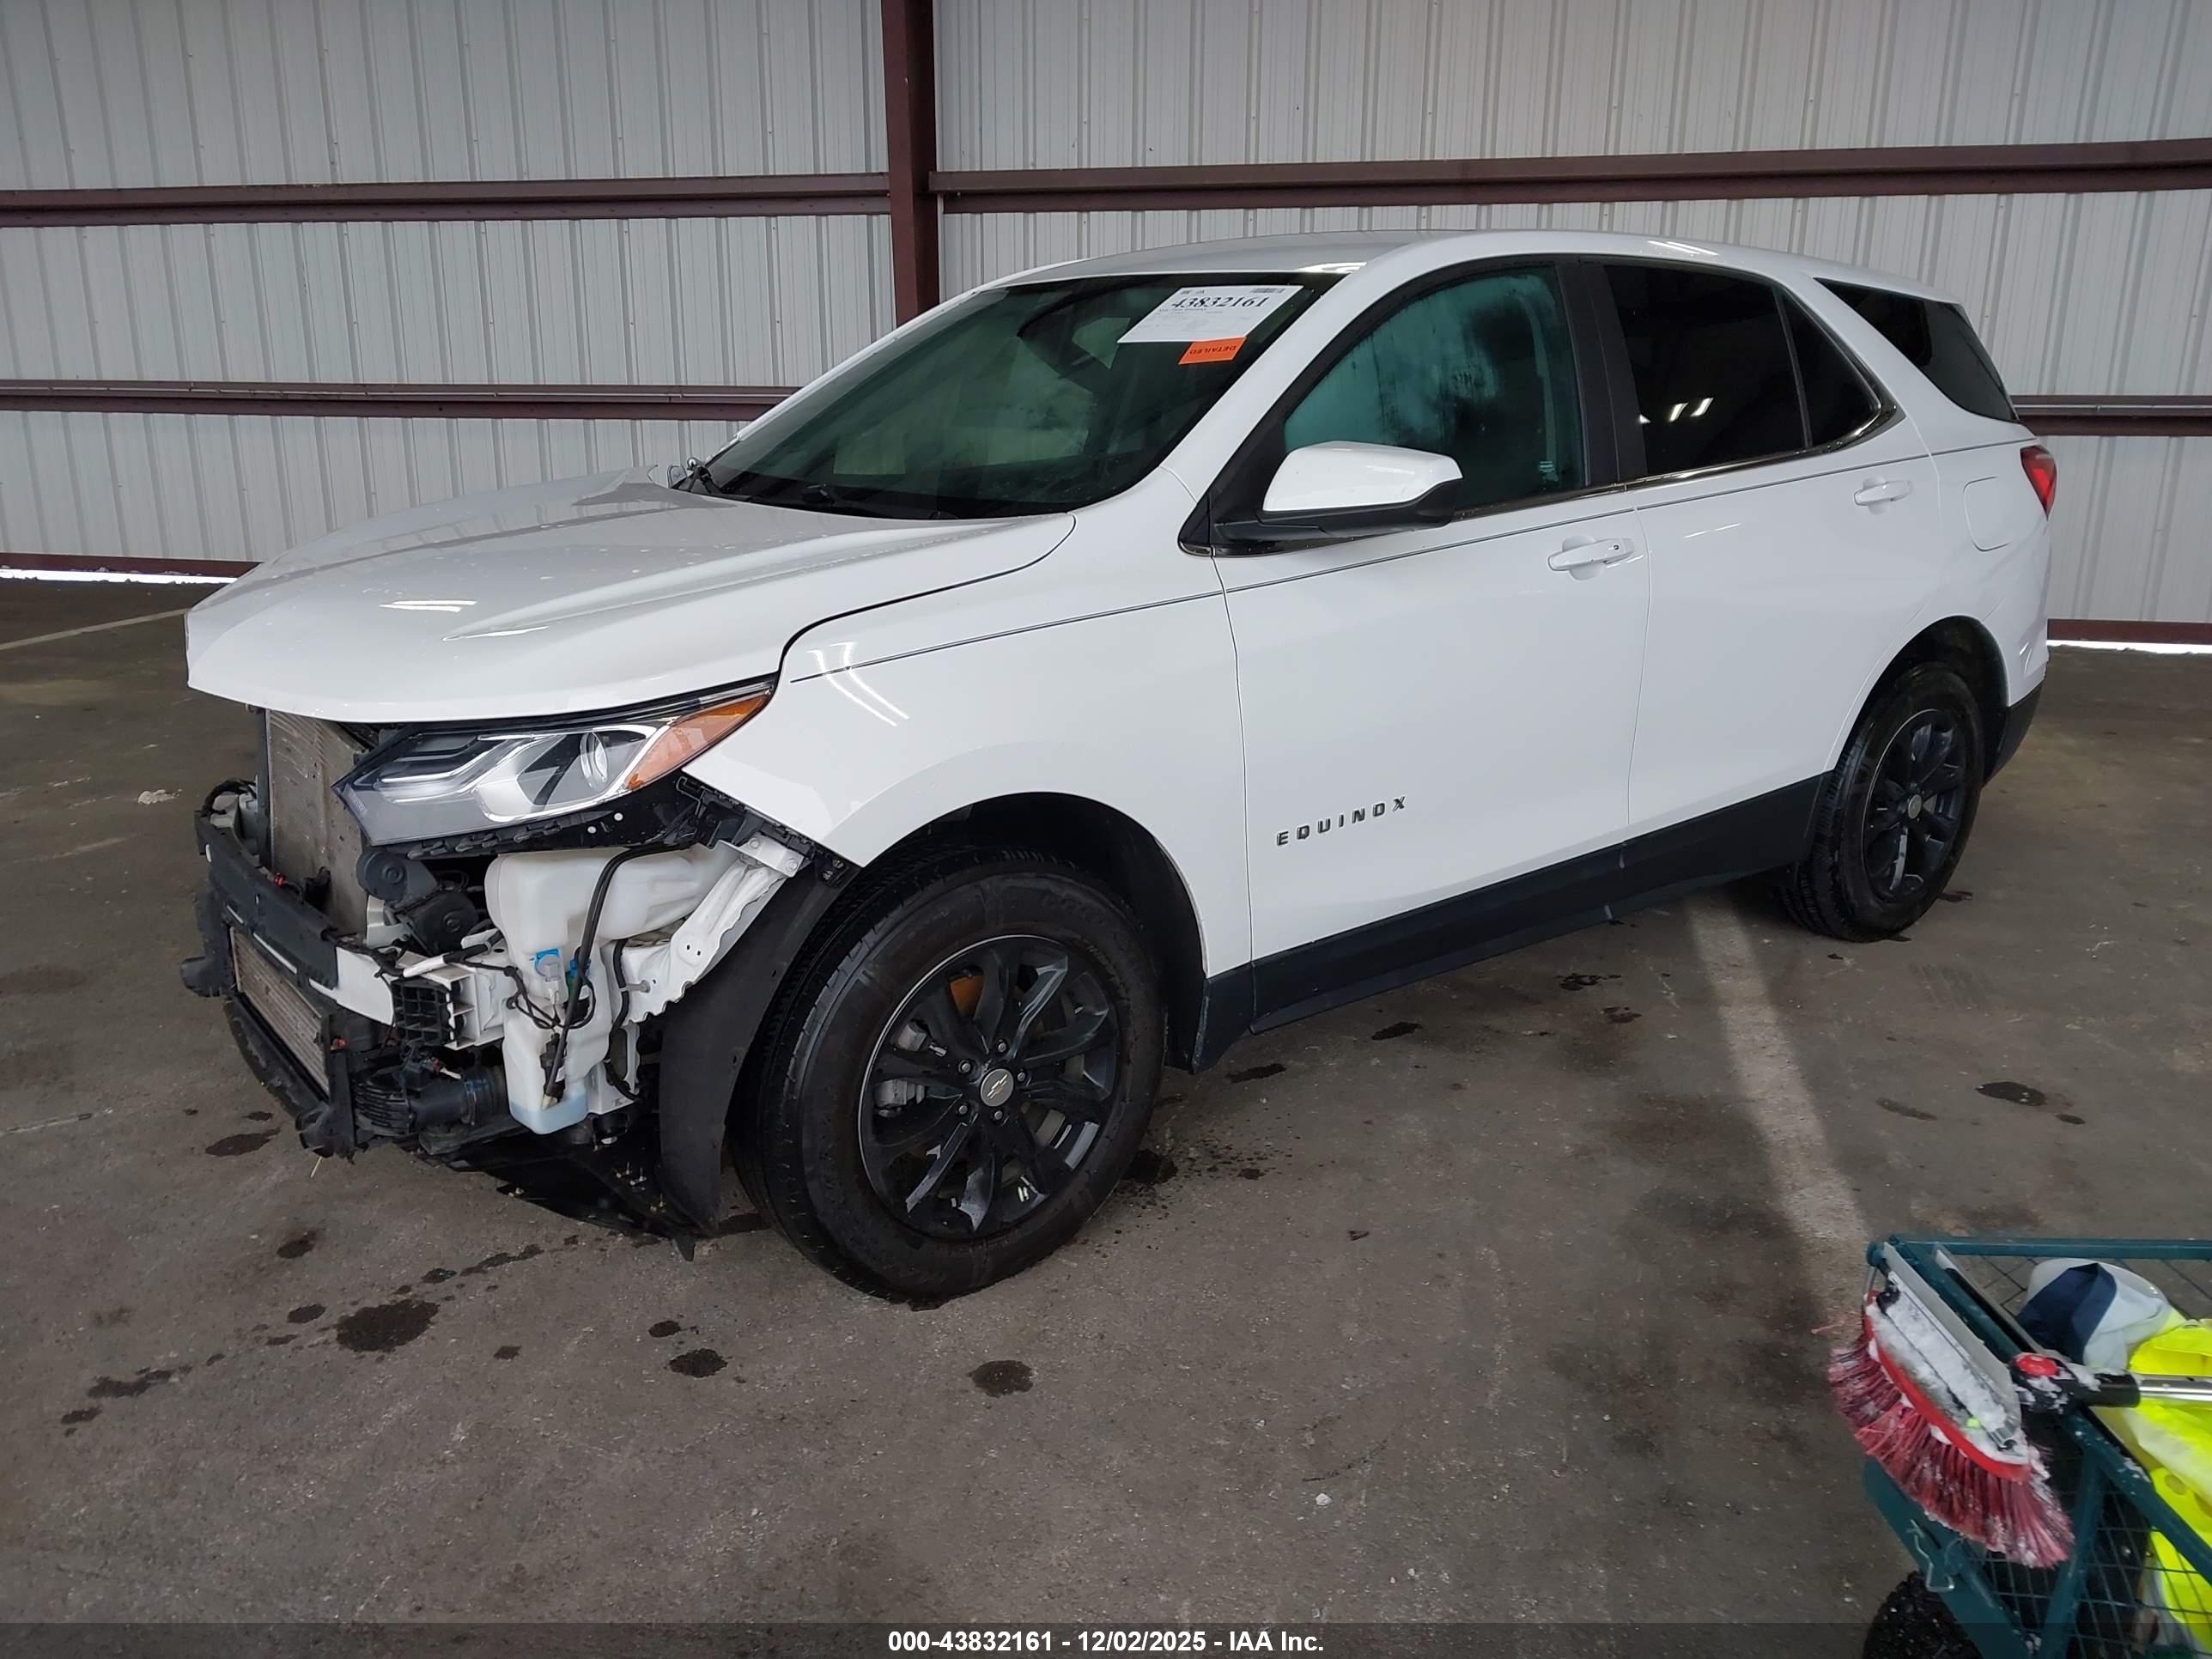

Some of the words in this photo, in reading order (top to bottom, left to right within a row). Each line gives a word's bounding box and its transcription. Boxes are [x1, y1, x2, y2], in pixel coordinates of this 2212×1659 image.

[1171, 296, 1270, 308] 43832161
[1189, 345, 1237, 355] DETAILED
[1276, 796, 1407, 847] EQUINOX
